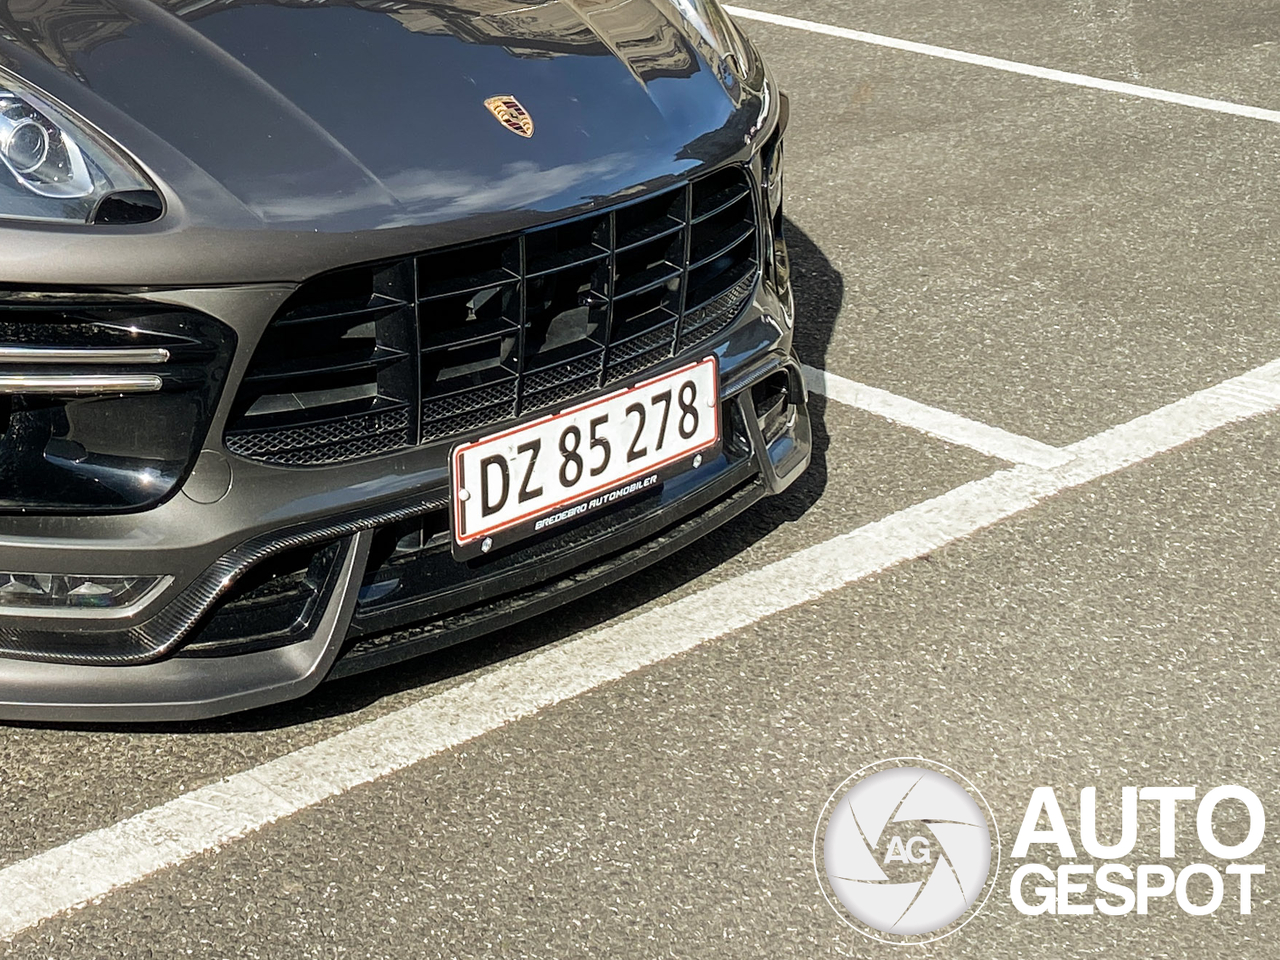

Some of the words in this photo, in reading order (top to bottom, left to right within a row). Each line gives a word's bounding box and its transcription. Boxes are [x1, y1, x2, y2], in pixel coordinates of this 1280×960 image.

[481, 438, 543, 518] DZ
[558, 413, 611, 488] 85
[625, 379, 699, 463] 278
[534, 502, 588, 531] BREDEBRO
[588, 474, 658, 510] AUTOMOBILER
